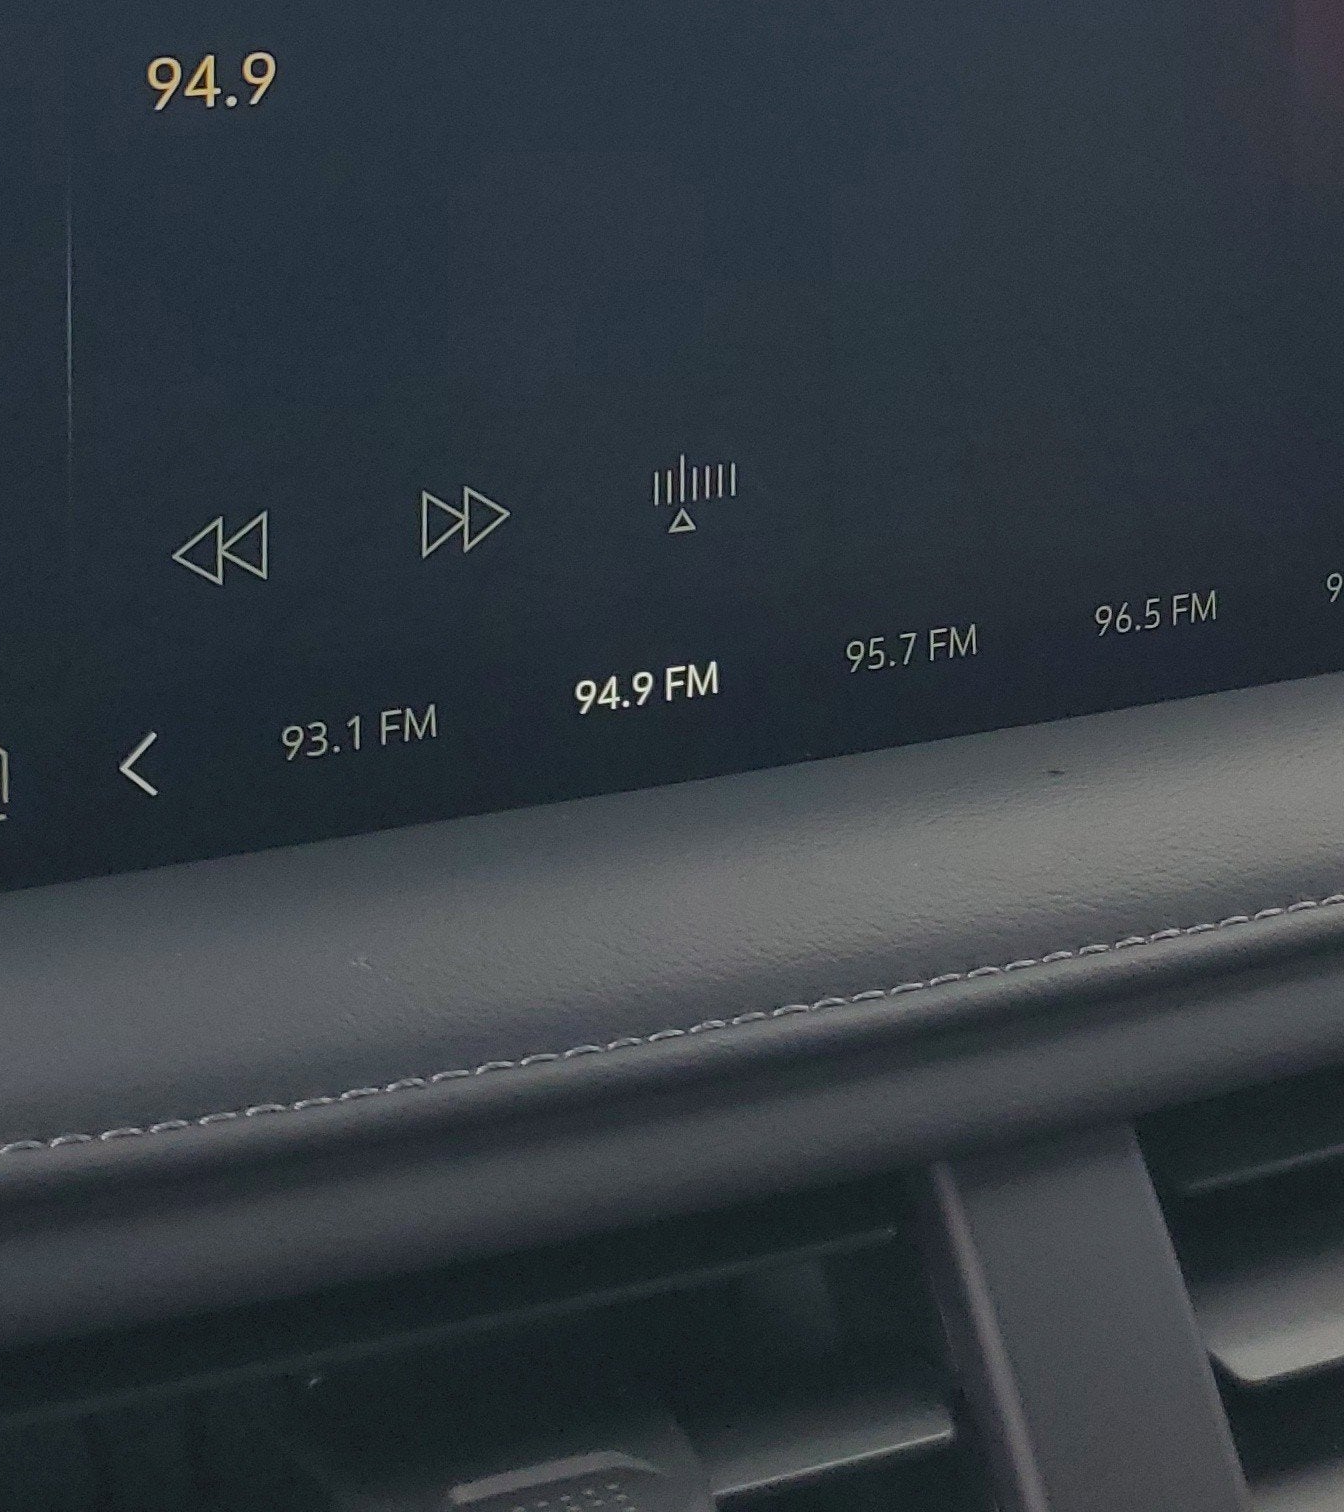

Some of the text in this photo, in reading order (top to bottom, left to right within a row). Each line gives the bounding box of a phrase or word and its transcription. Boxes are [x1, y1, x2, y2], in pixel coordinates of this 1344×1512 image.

[146, 51, 277, 111] 94.9
[1094, 589, 1218, 637] 96.5 FM
[845, 623, 978, 673] 95.7 FM
[575, 660, 720, 715] 94.9 FM
[281, 704, 438, 761] 93.1 FM
